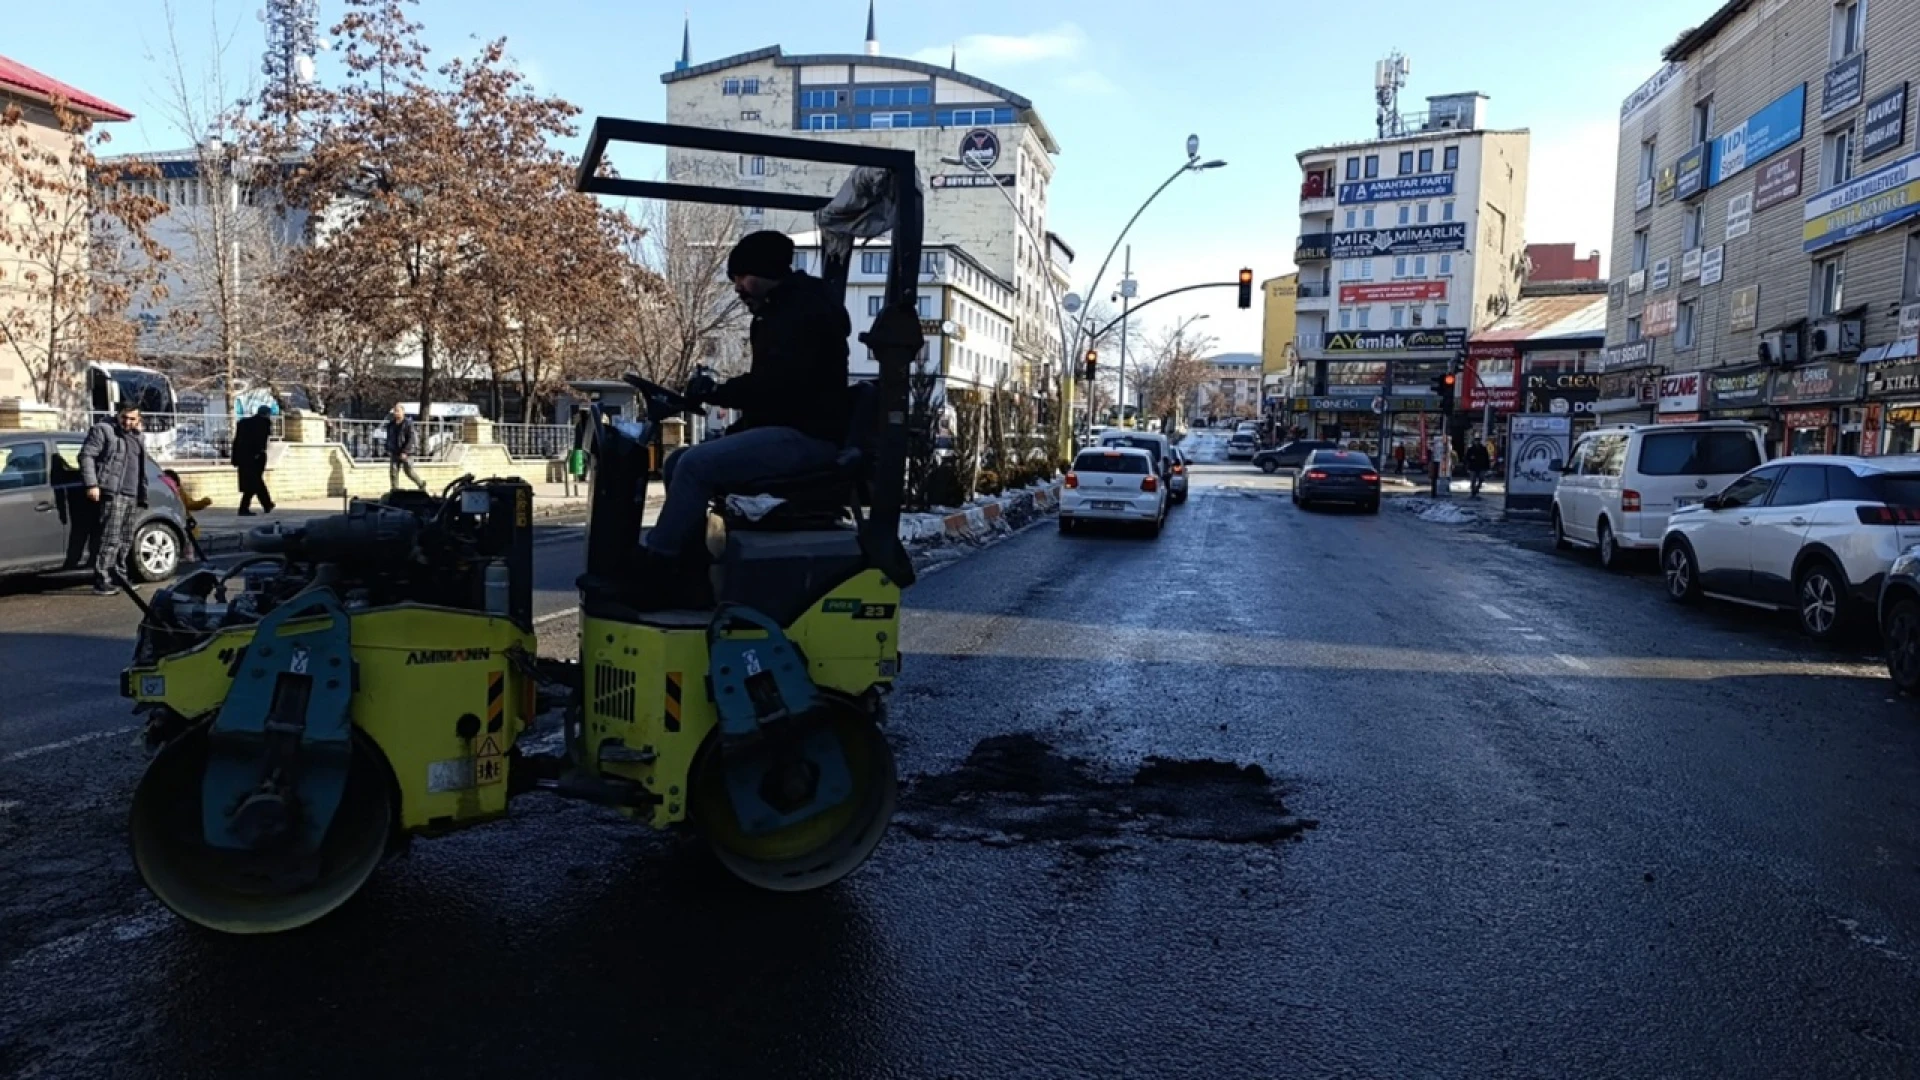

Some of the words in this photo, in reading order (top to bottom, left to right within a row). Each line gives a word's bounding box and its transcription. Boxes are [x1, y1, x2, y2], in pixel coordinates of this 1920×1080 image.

[1370, 179, 1418, 191] ANAHTAR
[1334, 231, 1372, 247] MİR
[1394, 226, 1464, 243] MİMARLIK
[1661, 374, 1697, 397] ECZANE
[864, 606, 885, 617] 23
[405, 647, 490, 666] AMMANN
